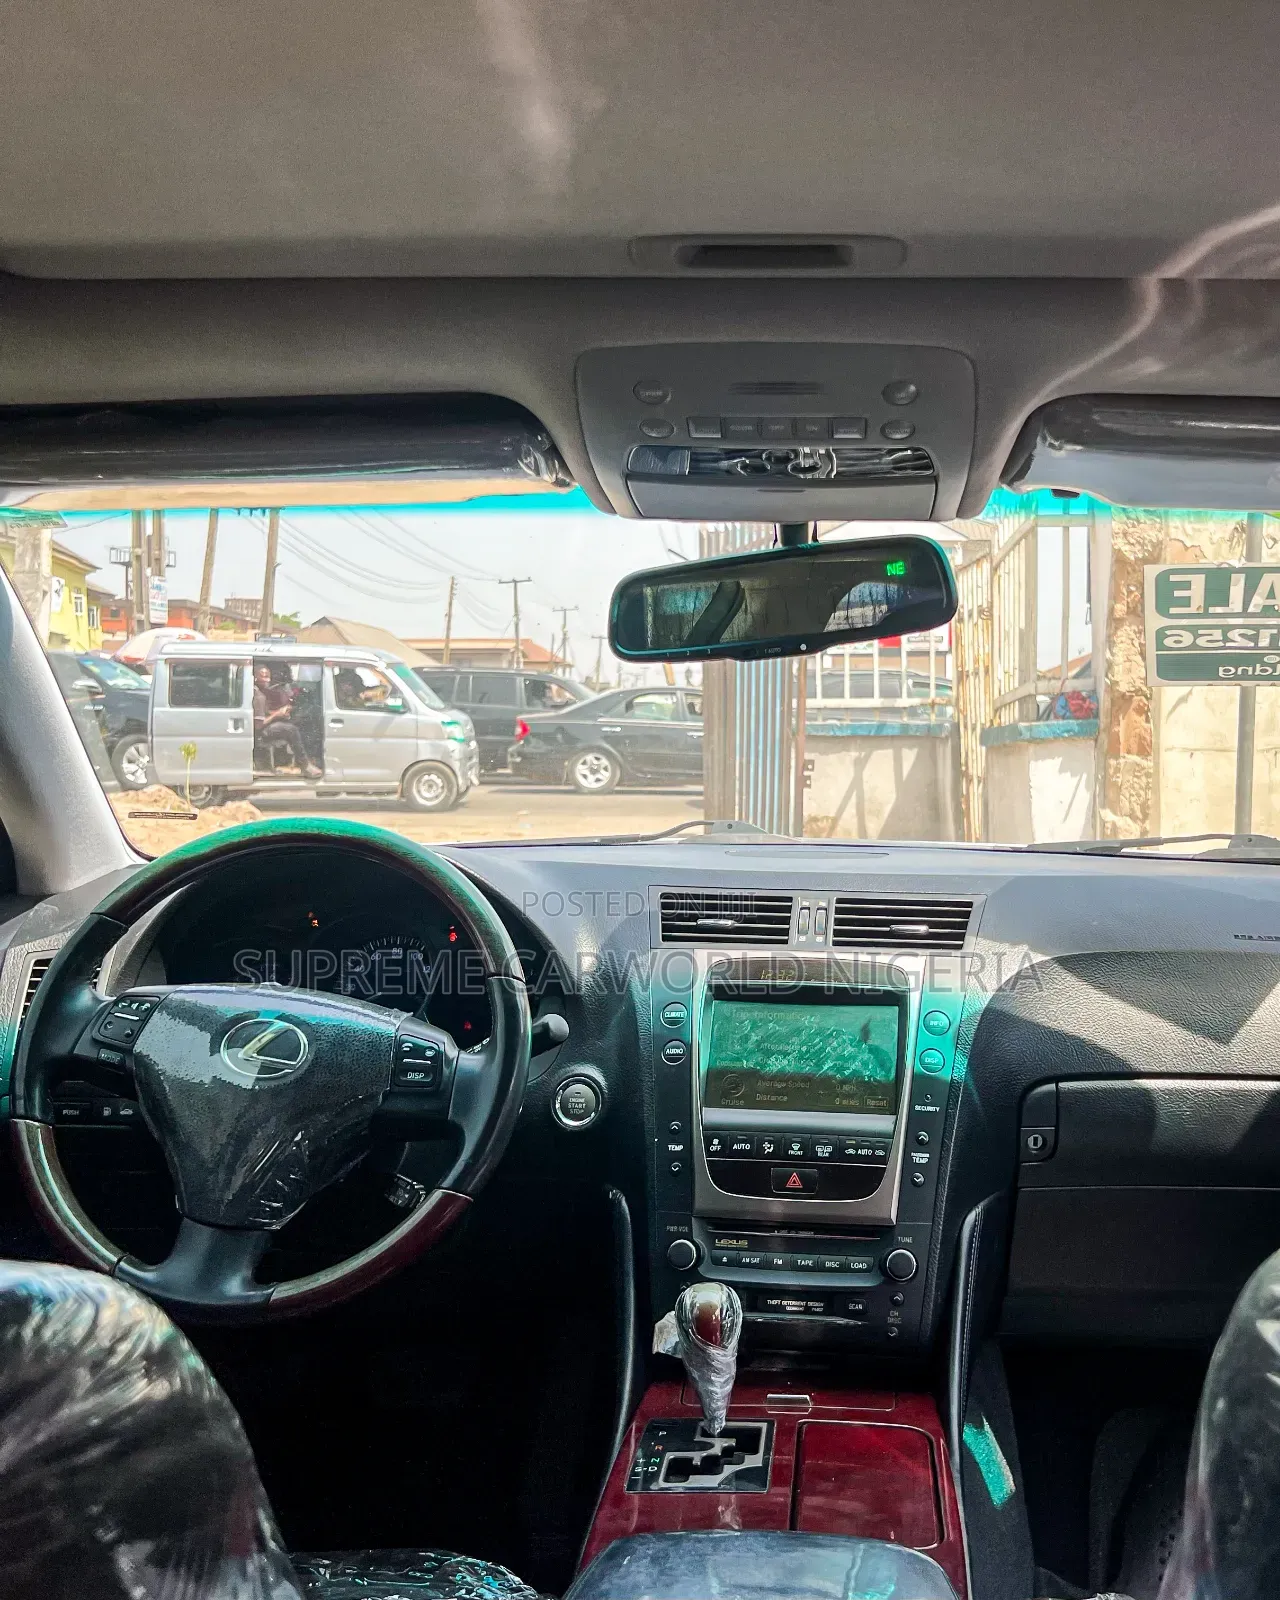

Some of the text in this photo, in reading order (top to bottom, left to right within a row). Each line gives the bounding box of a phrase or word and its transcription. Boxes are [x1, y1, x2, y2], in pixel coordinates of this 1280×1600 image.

[886, 561, 905, 576] NE
[665, 1047, 684, 1055] AUDIO
[101, 1053, 121, 1065] MODE
[406, 1071, 425, 1079] DISP
[755, 1093, 788, 1103] Distance
[866, 1099, 888, 1108] Reset
[914, 1104, 941, 1112] SECURITY
[709, 1144, 722, 1152] OFF
[857, 1148, 873, 1156] AUTO
[797, 1259, 814, 1267] TAPE
[848, 1302, 863, 1310] SCAN
